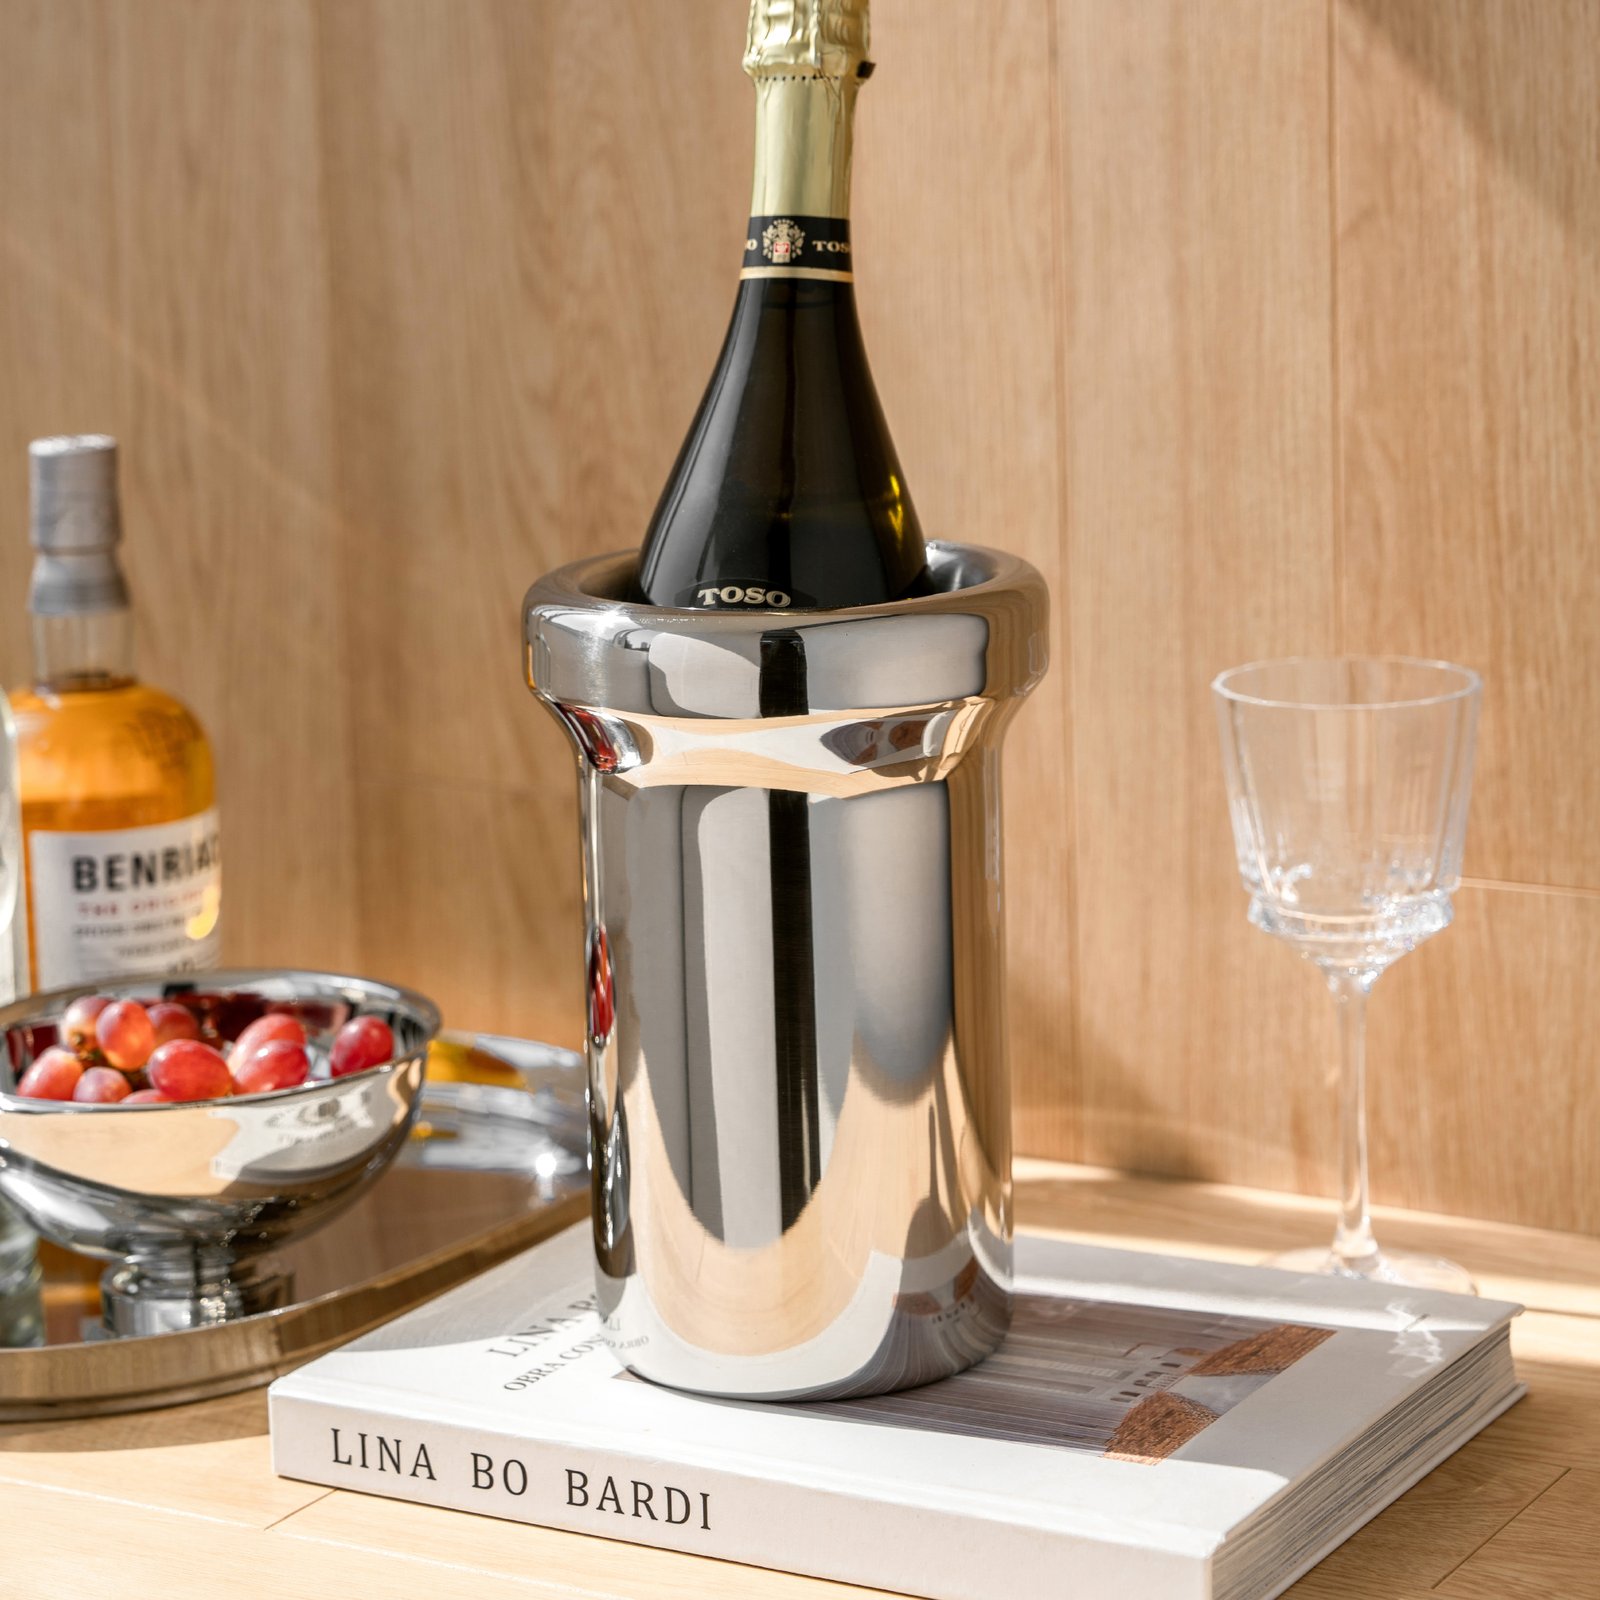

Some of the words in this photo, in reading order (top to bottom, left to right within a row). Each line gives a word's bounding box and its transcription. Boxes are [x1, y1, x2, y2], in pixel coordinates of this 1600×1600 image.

[697, 586, 791, 608] TOSO
[486, 1316, 583, 1357] LINA
[503, 1363, 567, 1391] OBRA
[331, 1428, 437, 1481] LINA
[470, 1452, 529, 1496] BO
[565, 1469, 712, 1530] BARDI
